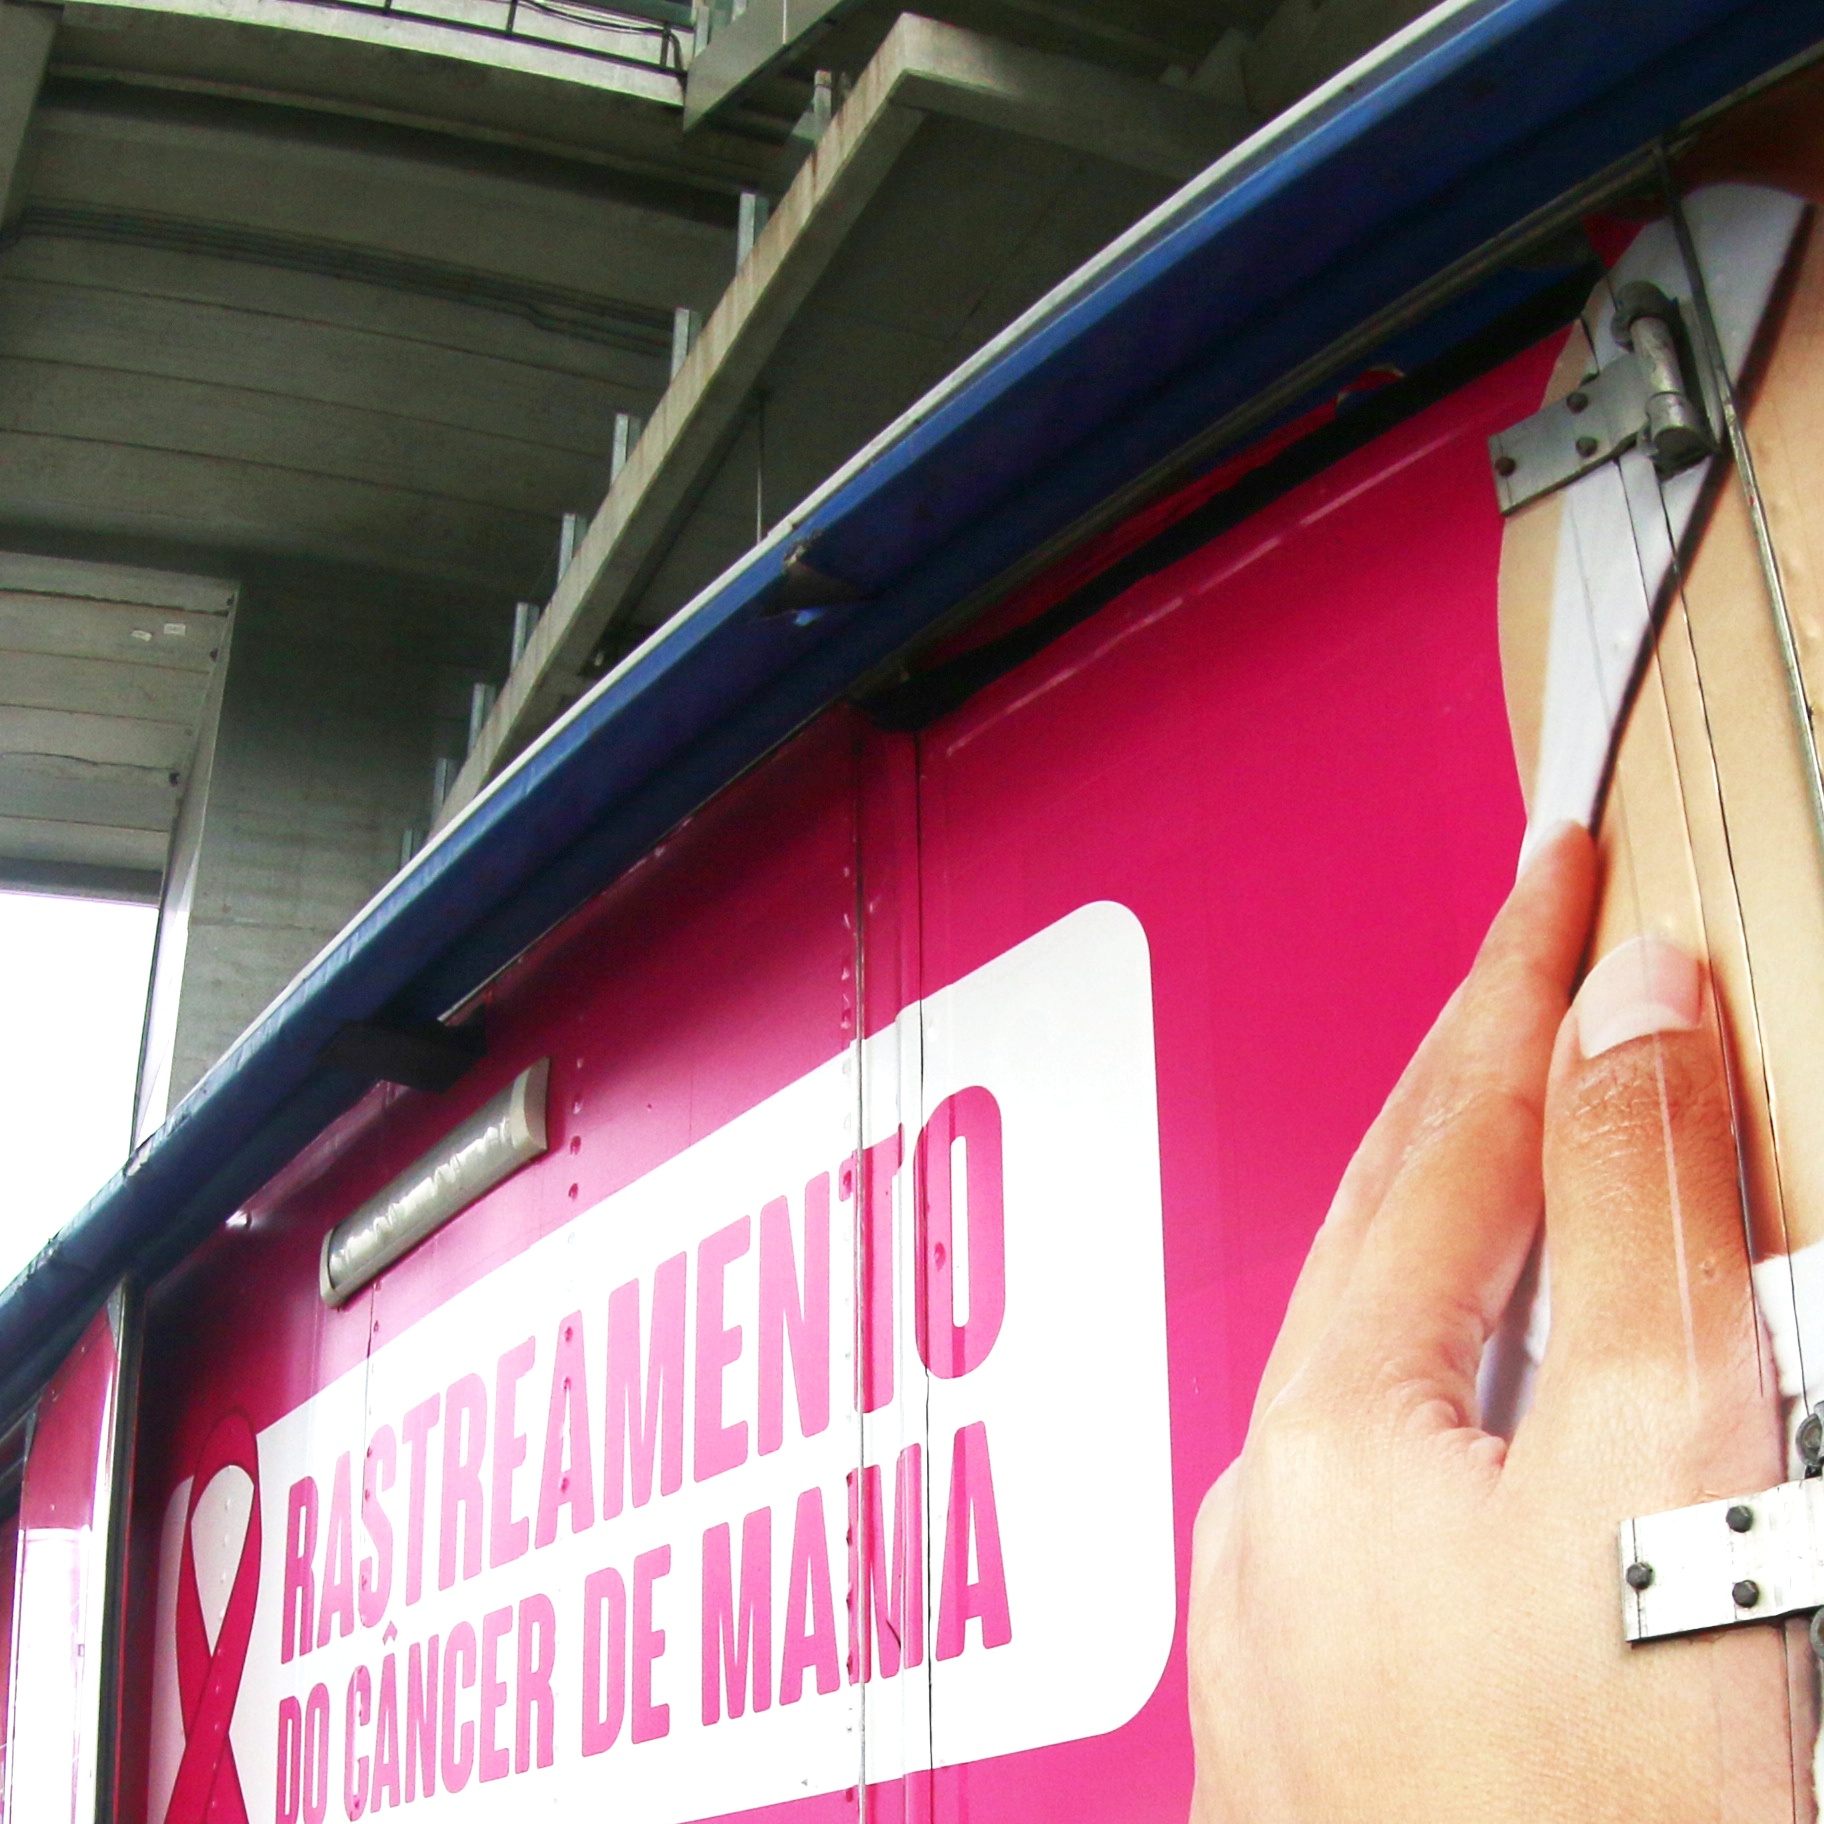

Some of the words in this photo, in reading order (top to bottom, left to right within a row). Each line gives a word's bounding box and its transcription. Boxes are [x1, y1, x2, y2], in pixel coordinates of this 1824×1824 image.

[280, 1085, 1006, 1664] RASTREAMENTO
[344, 1594, 554, 1822] CÂNCER
[582, 1543, 671, 1759] DE
[702, 1420, 1013, 1727] MAMA
